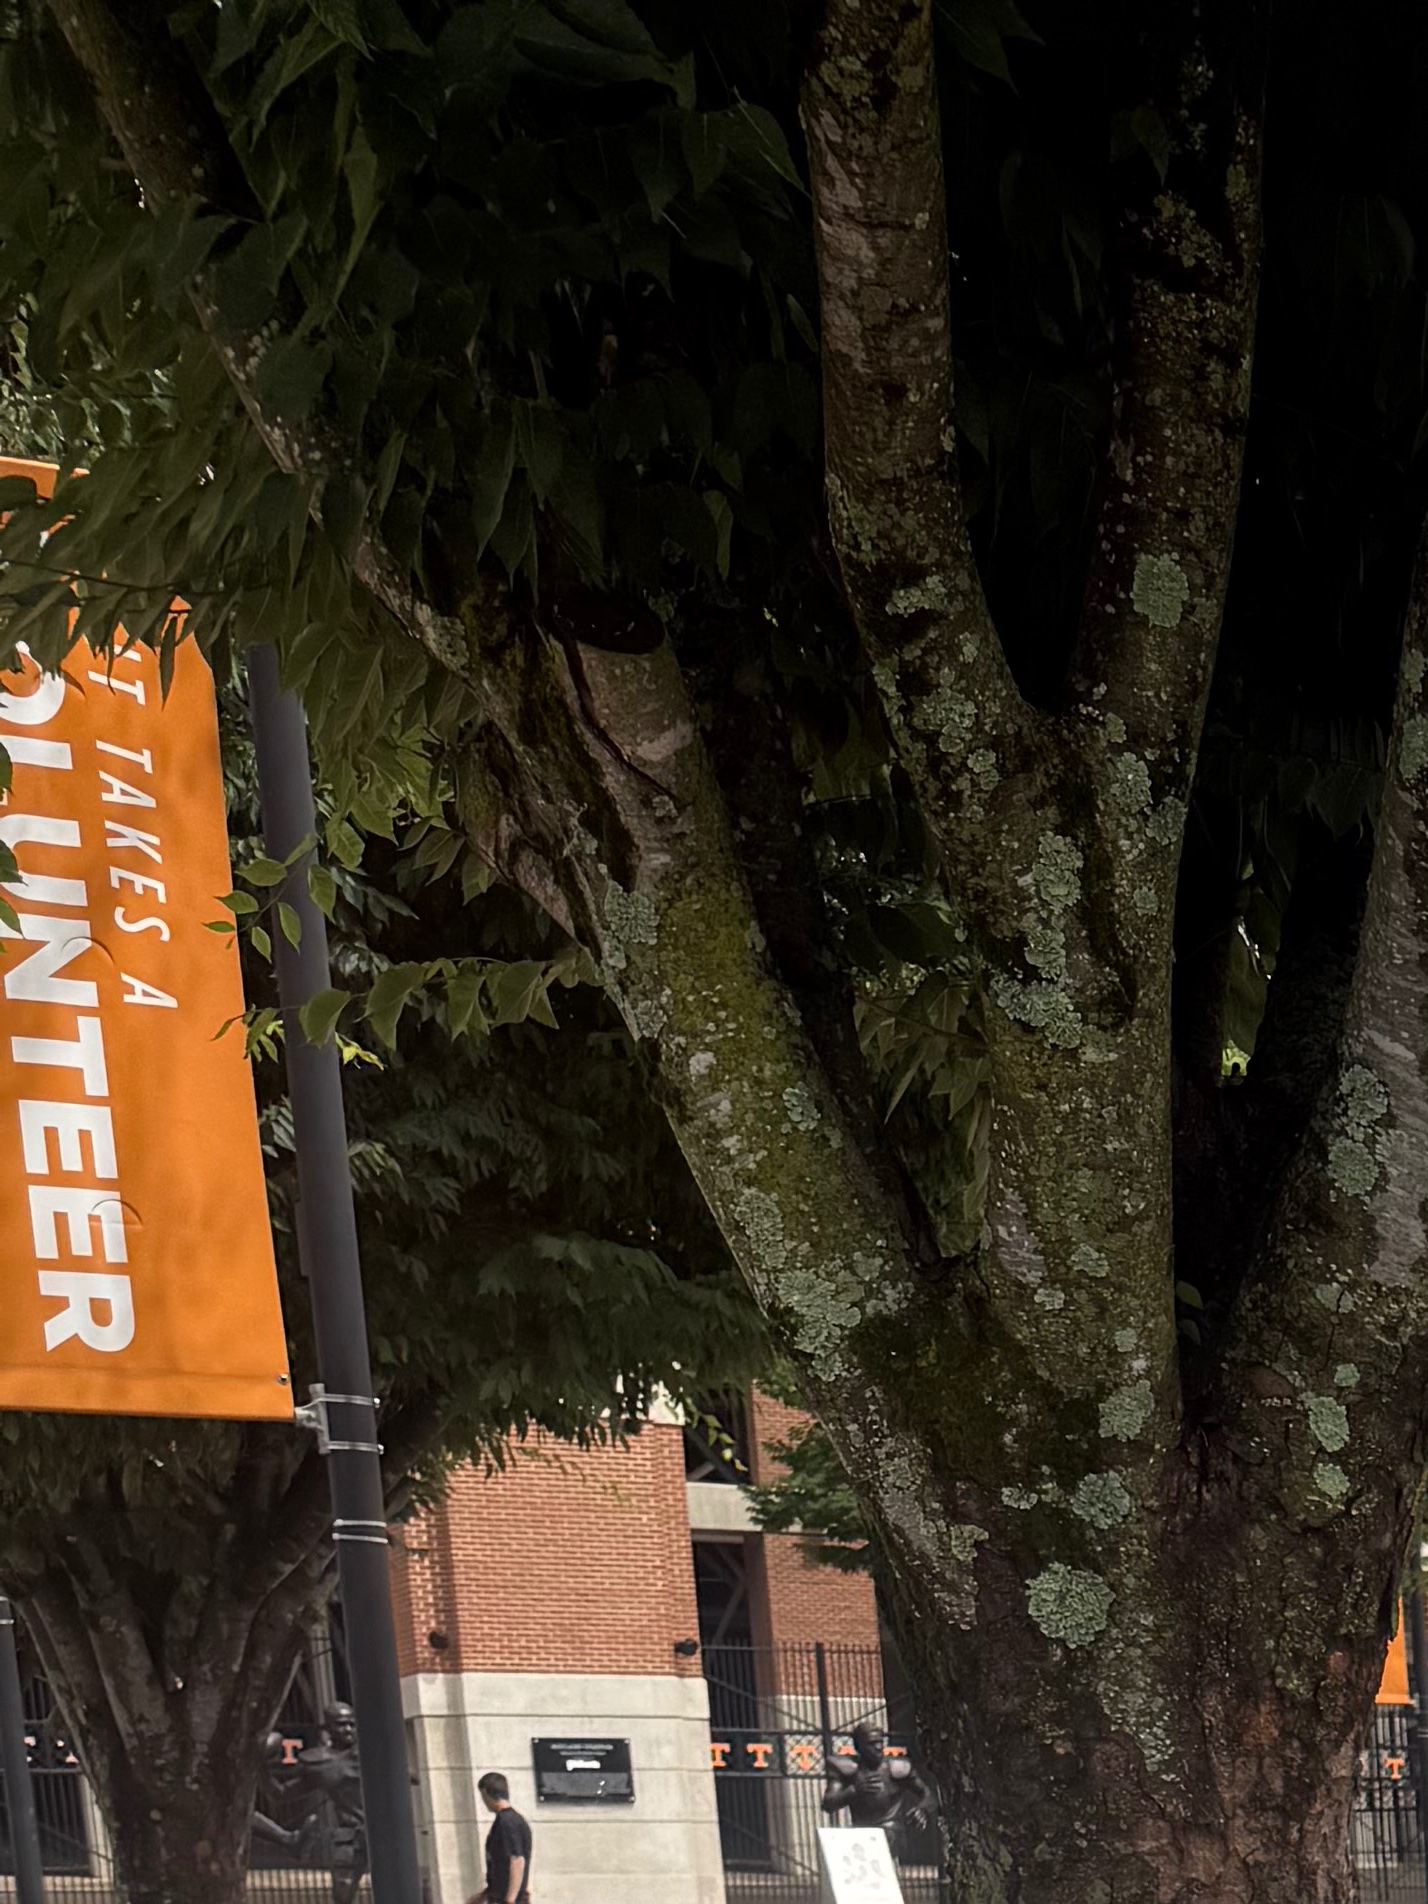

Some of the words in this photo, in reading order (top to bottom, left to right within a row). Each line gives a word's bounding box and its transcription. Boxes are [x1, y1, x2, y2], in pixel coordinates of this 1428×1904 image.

[96, 740, 171, 942] TAKES
[0, 640, 136, 1352] OLUNTEER
[120, 972, 178, 1008] A
[709, 1743, 731, 1767] T
[746, 1743, 773, 1768] T
[1384, 1757, 1405, 1780] T
